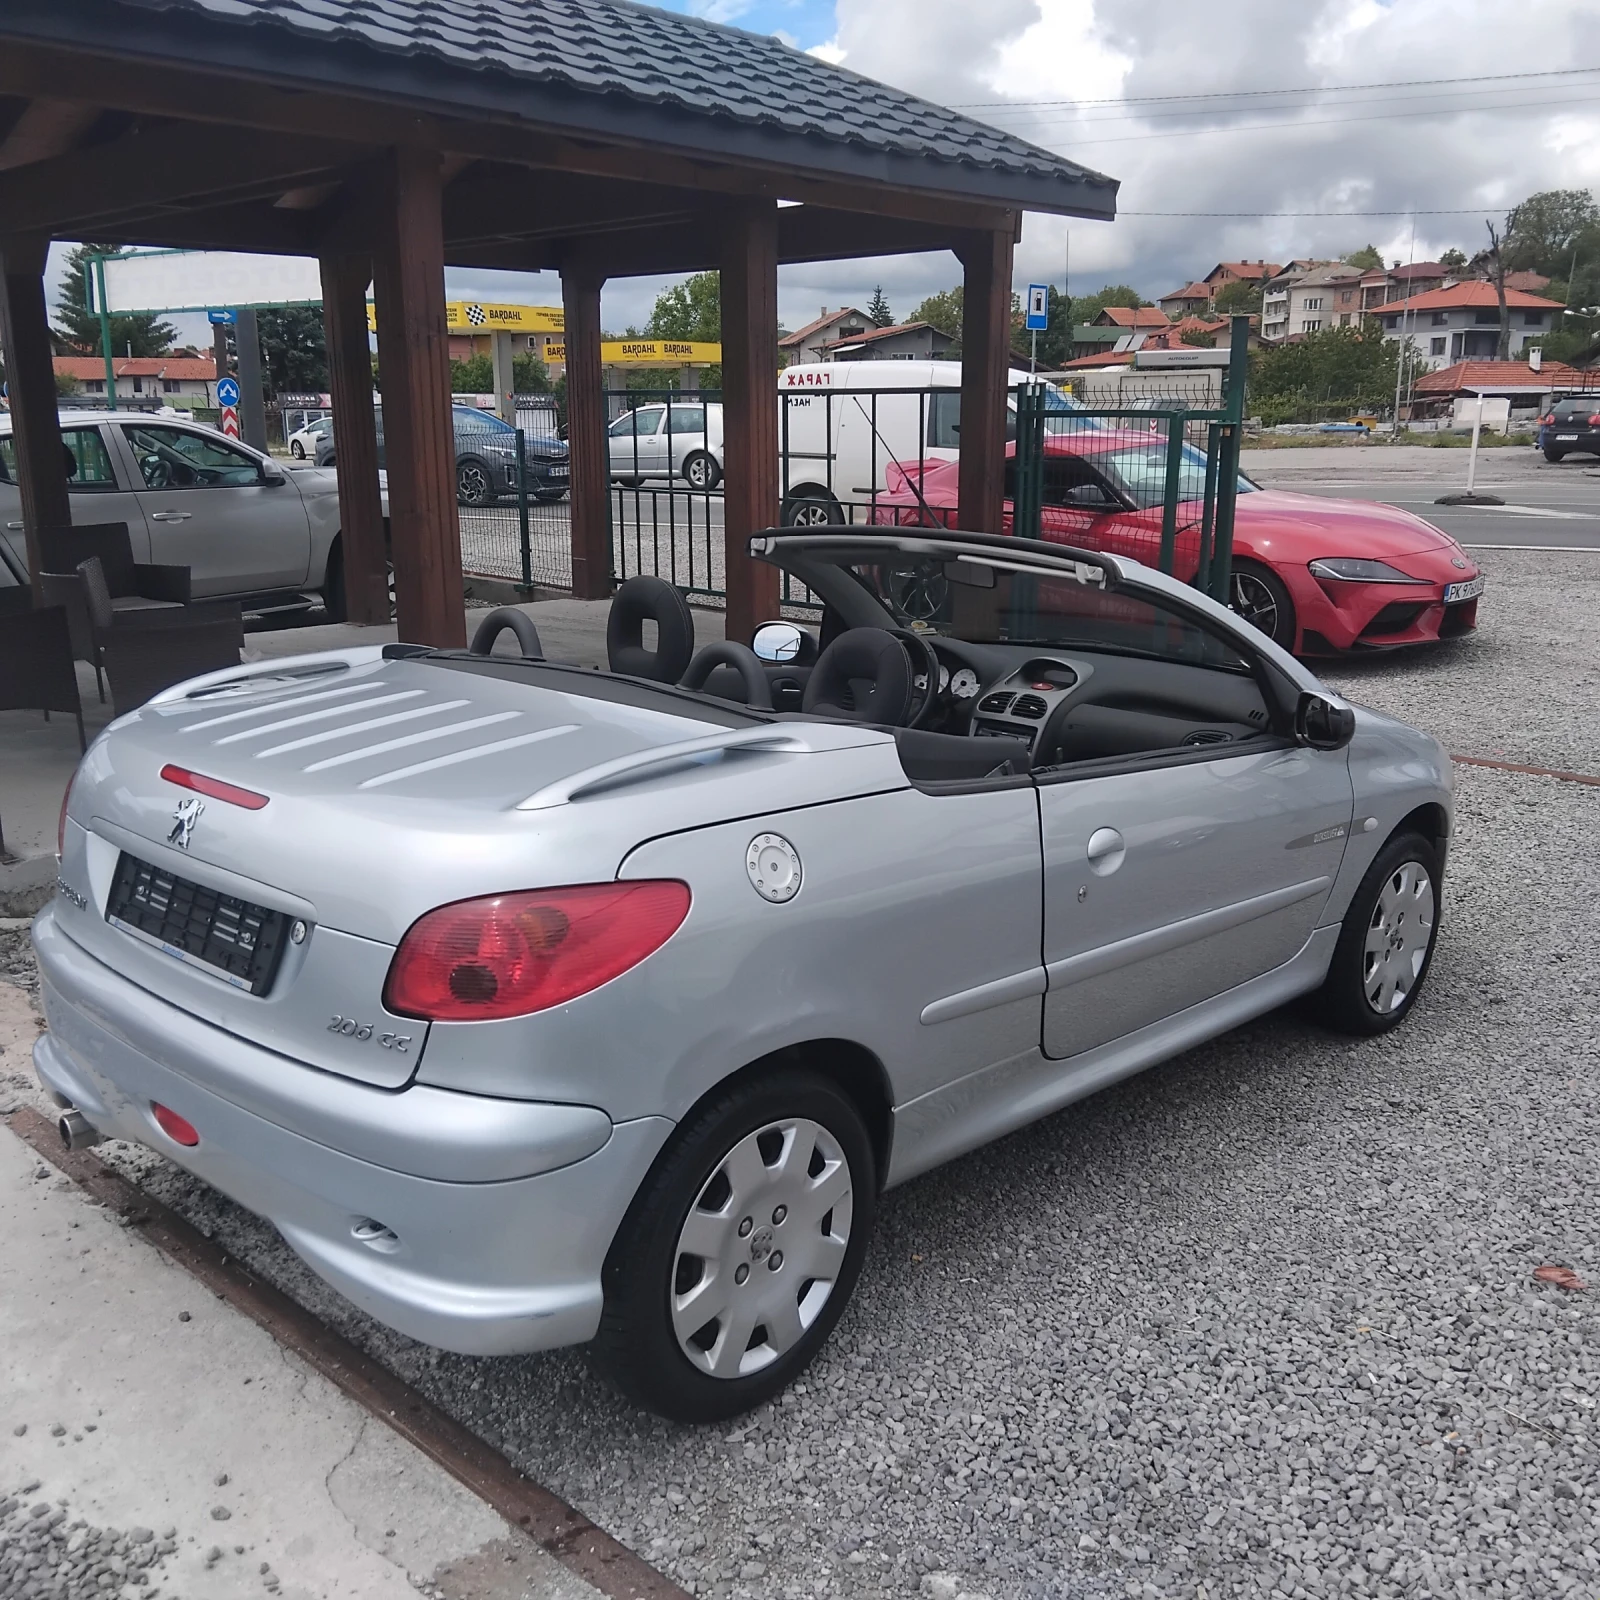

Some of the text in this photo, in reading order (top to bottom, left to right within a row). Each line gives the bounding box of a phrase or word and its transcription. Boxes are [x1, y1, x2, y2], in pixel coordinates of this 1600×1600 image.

[489, 310, 522, 324] BARDAHL
[622, 344, 657, 357] BARDAHL
[664, 344, 693, 357] BARDAHL
[1450, 585, 1462, 599] PK
[327, 1014, 412, 1053] 206 CC
